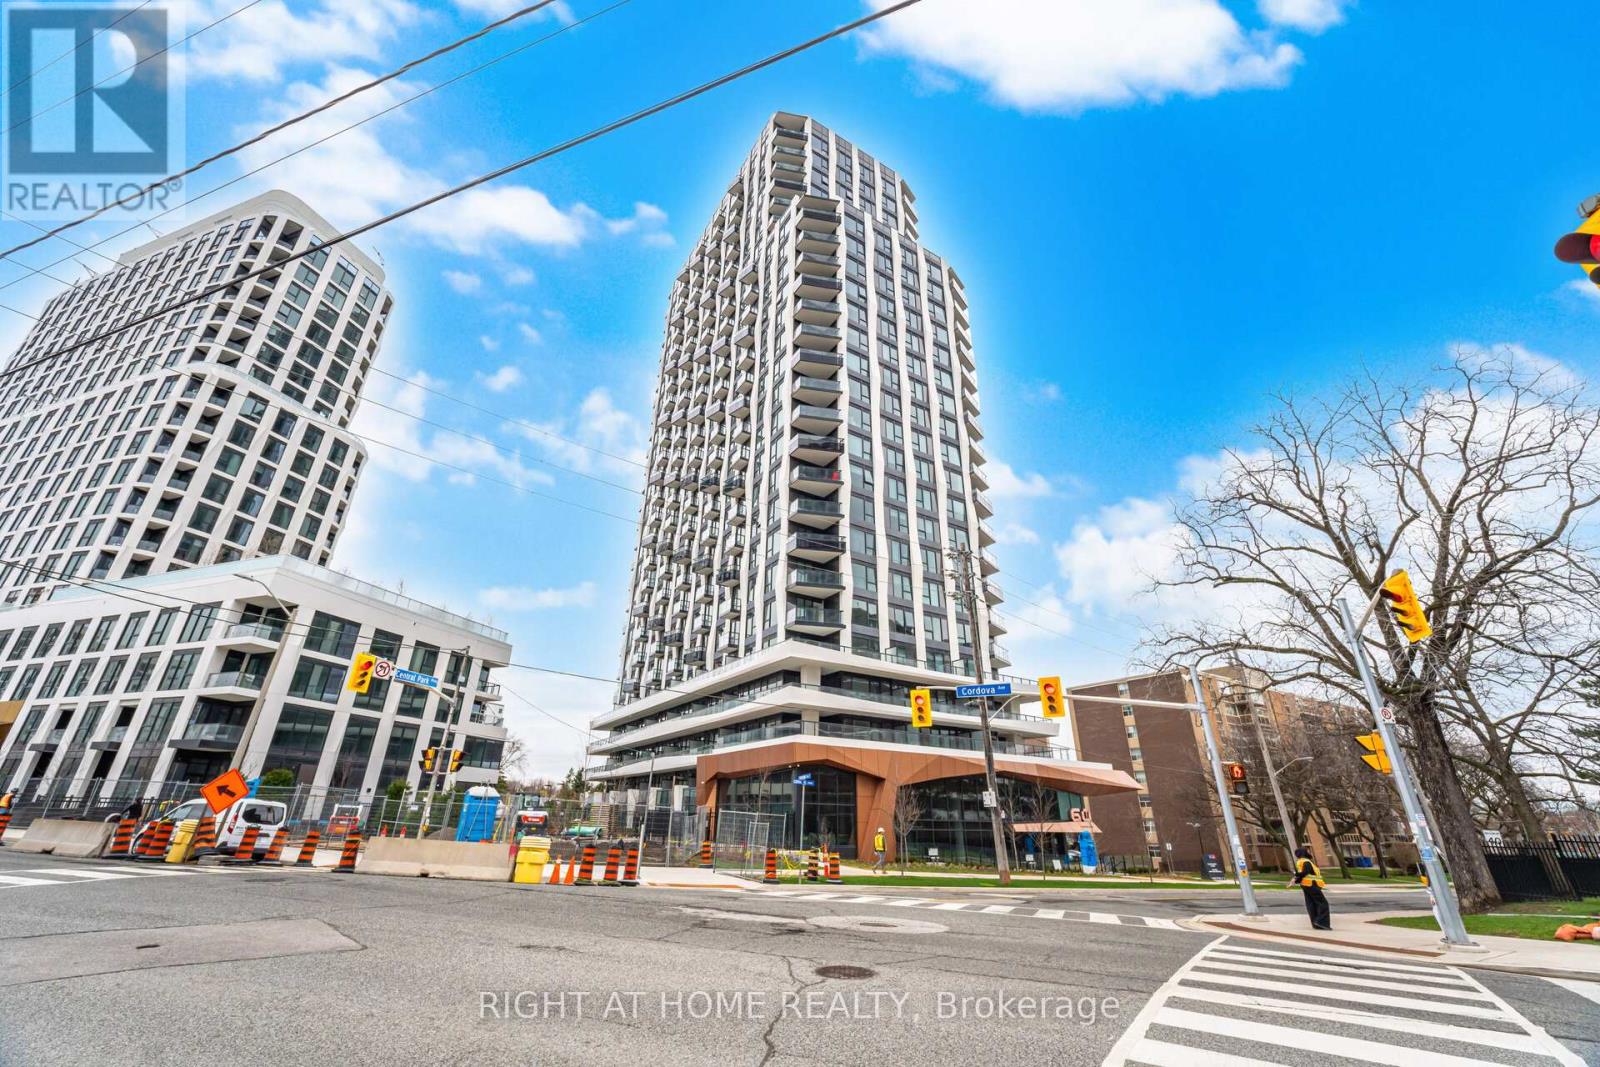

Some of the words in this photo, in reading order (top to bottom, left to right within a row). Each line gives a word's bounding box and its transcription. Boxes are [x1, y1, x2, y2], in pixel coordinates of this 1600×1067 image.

[396, 670, 416, 681] Central
[417, 675, 429, 684] Park
[961, 687, 996, 695] Cordova
